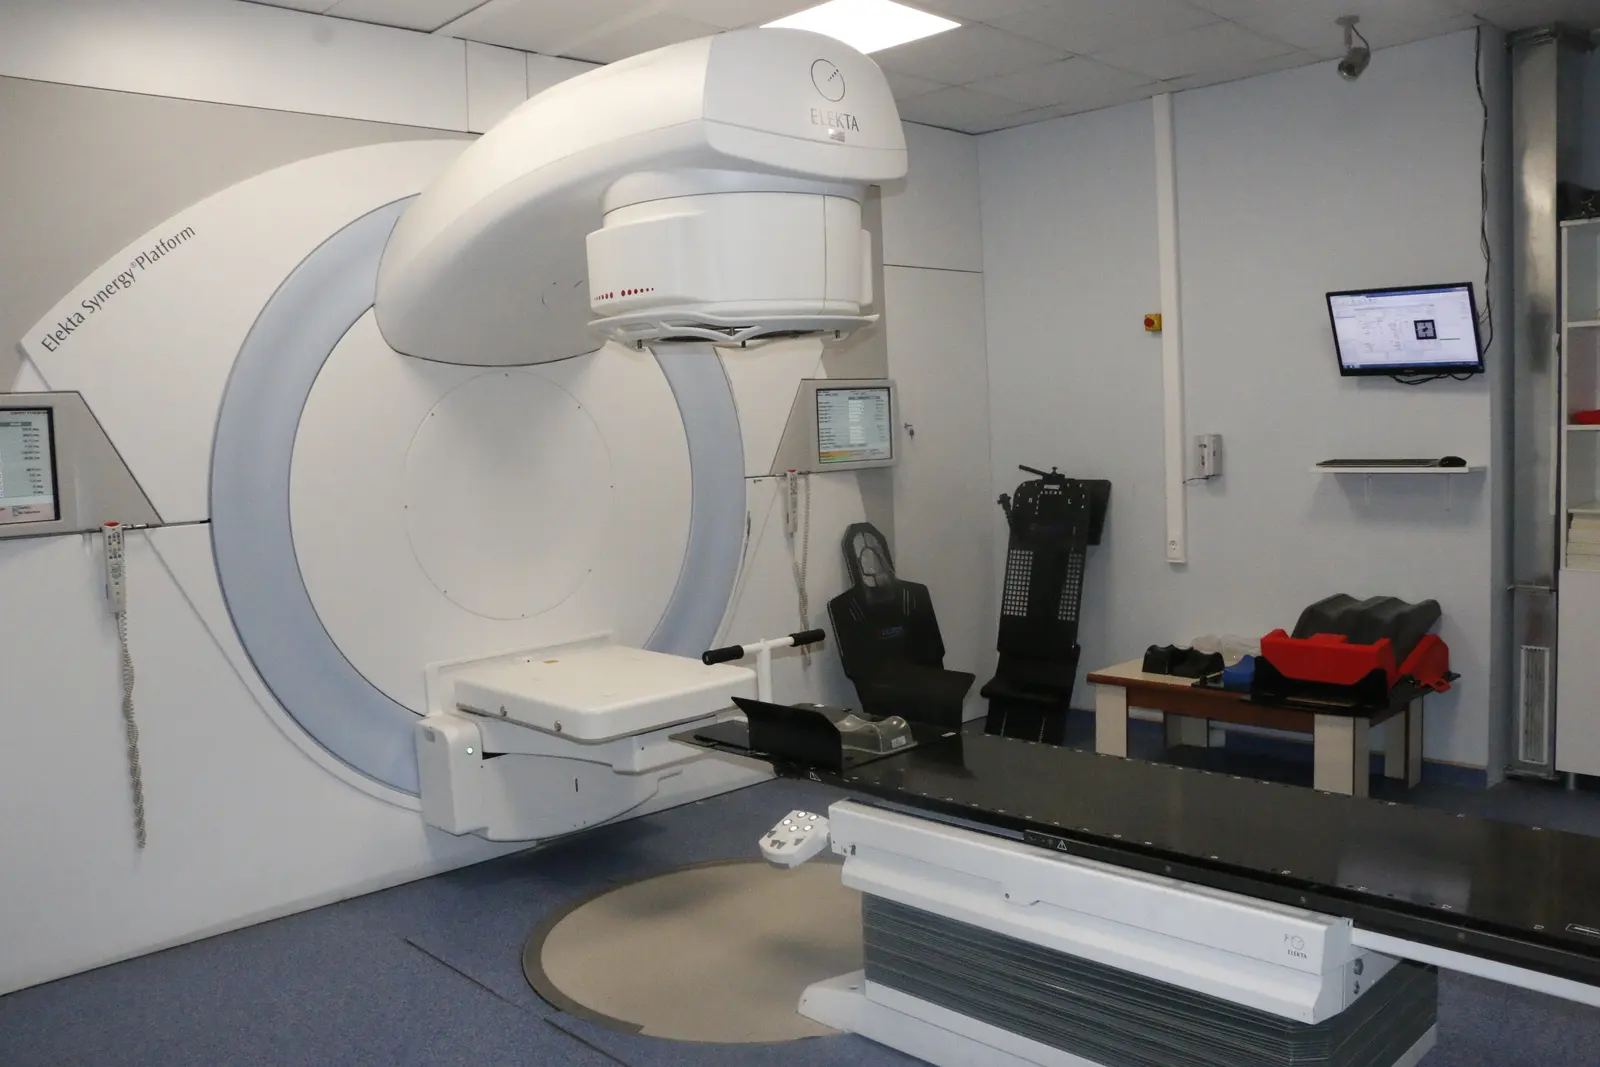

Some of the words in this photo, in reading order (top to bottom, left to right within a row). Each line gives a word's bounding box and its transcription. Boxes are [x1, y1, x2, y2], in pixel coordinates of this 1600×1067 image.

[810, 108, 860, 132] ELEKTA
[41, 311, 86, 352] Elekta
[135, 225, 196, 270] Platform
[1287, 949, 1308, 959] ELEKTA
